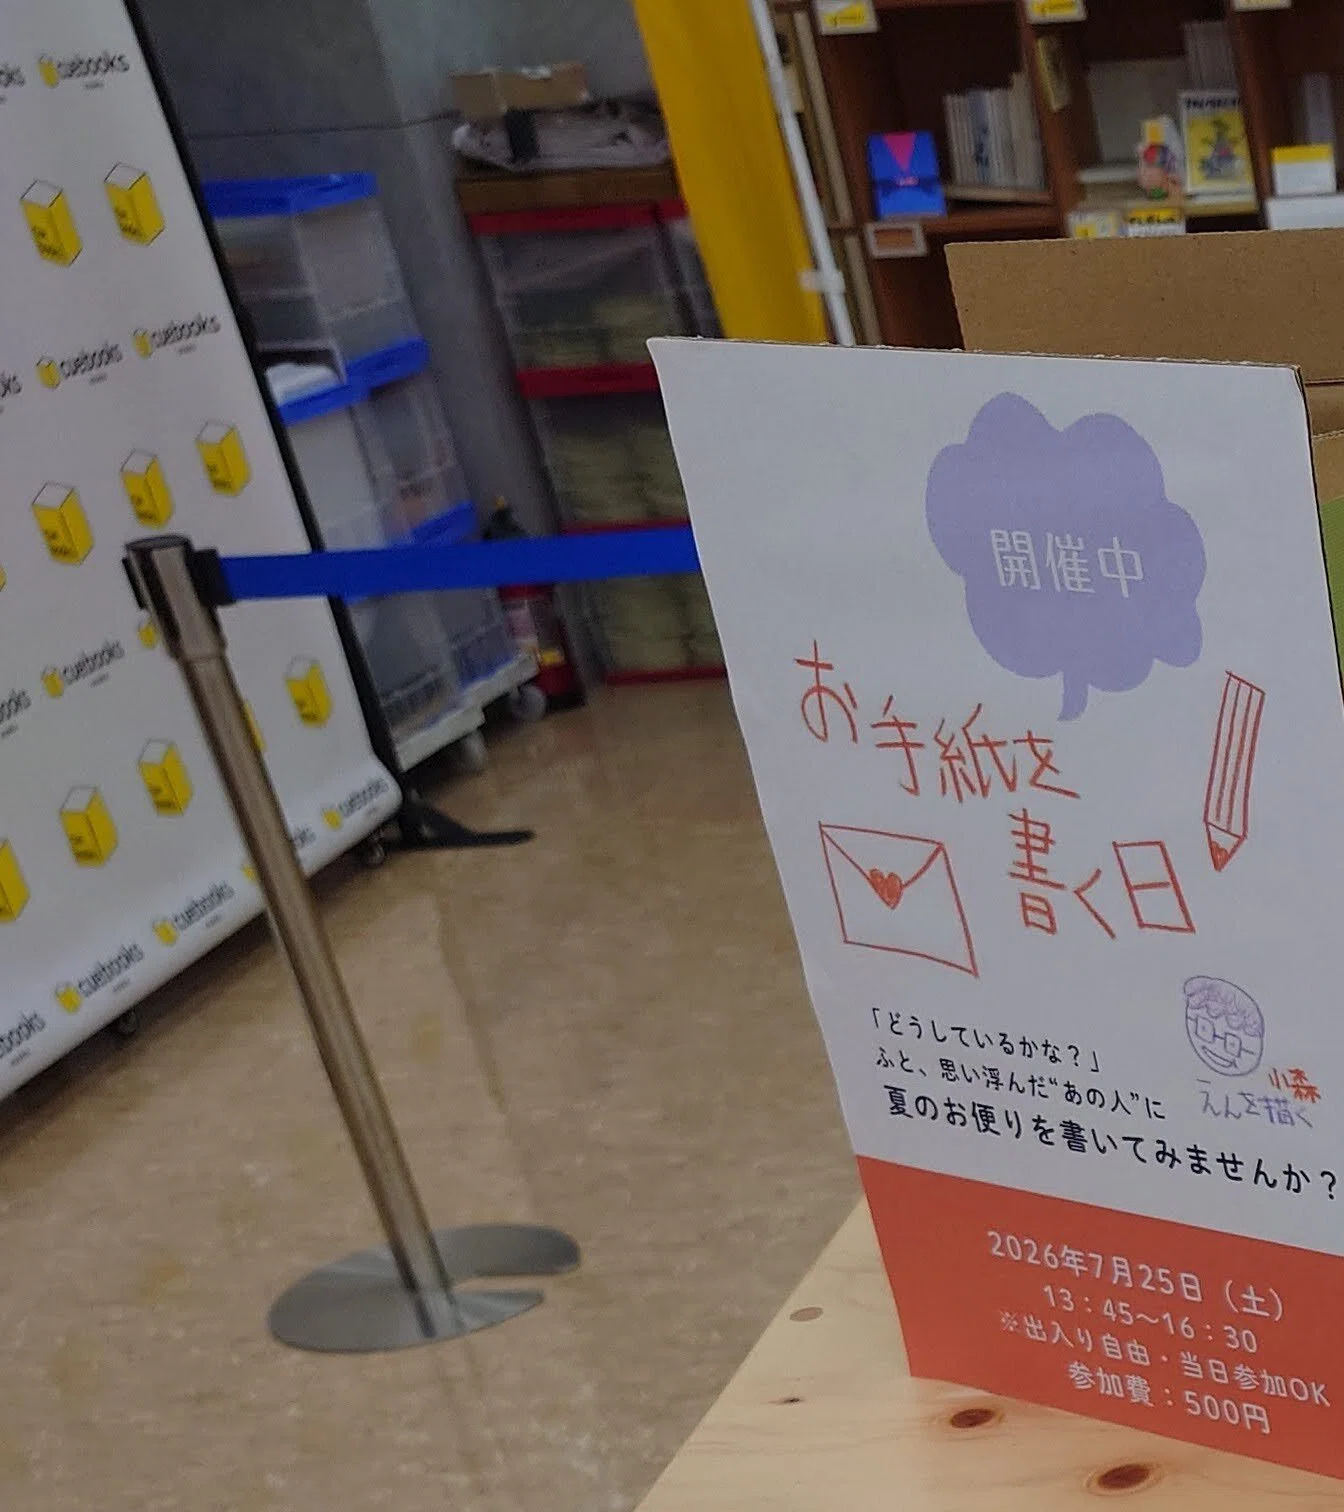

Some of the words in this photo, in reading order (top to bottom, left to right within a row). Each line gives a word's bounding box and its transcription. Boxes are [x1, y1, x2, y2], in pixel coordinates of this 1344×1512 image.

[990, 529, 1145, 598] 開催中
[793, 639, 1082, 804] お手紙を
[1007, 808, 1197, 941] 書く日
[871, 1006, 1100, 1073] 「どうしているかな？」
[883, 1084, 1338, 1200] 夏のお便りを書いてみませんか？
[1067, 1360, 1272, 1435] 参加費：500円
